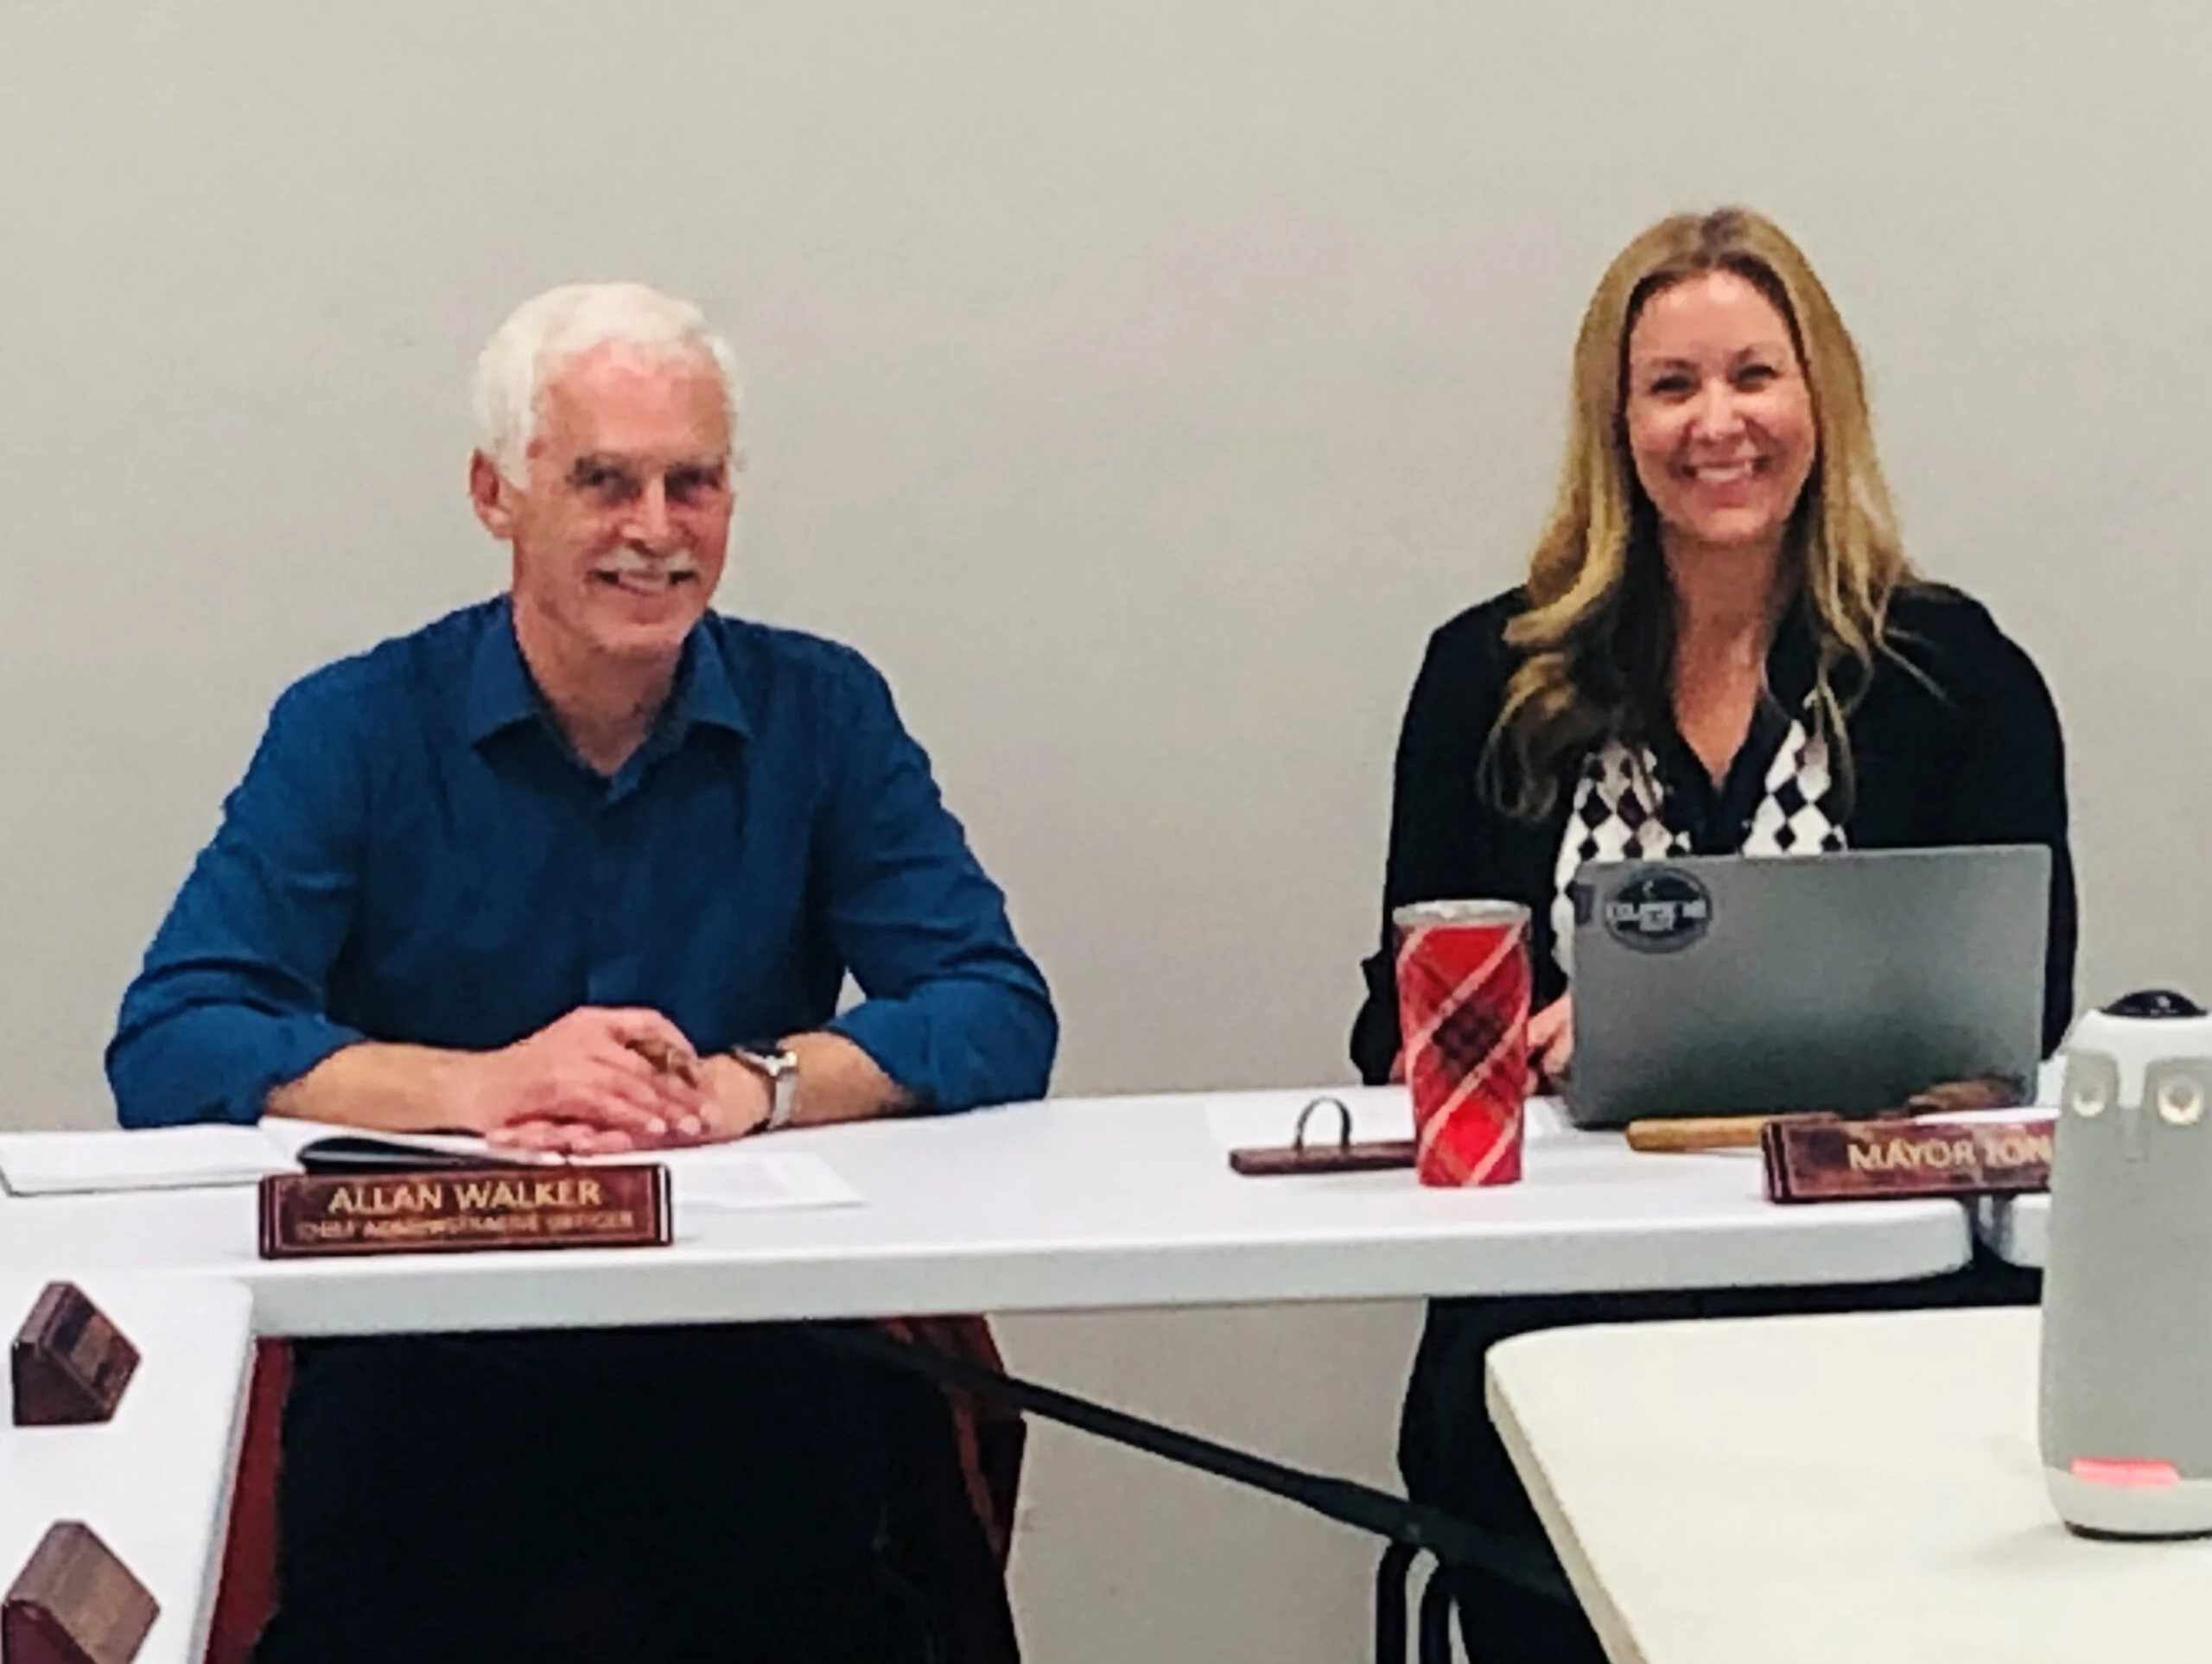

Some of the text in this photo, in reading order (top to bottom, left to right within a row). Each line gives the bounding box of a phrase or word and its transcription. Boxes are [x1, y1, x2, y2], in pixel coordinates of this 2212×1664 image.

[1847, 1138, 1976, 1170] MAYOR
[327, 1178, 602, 1214] ALLAN WALKER
